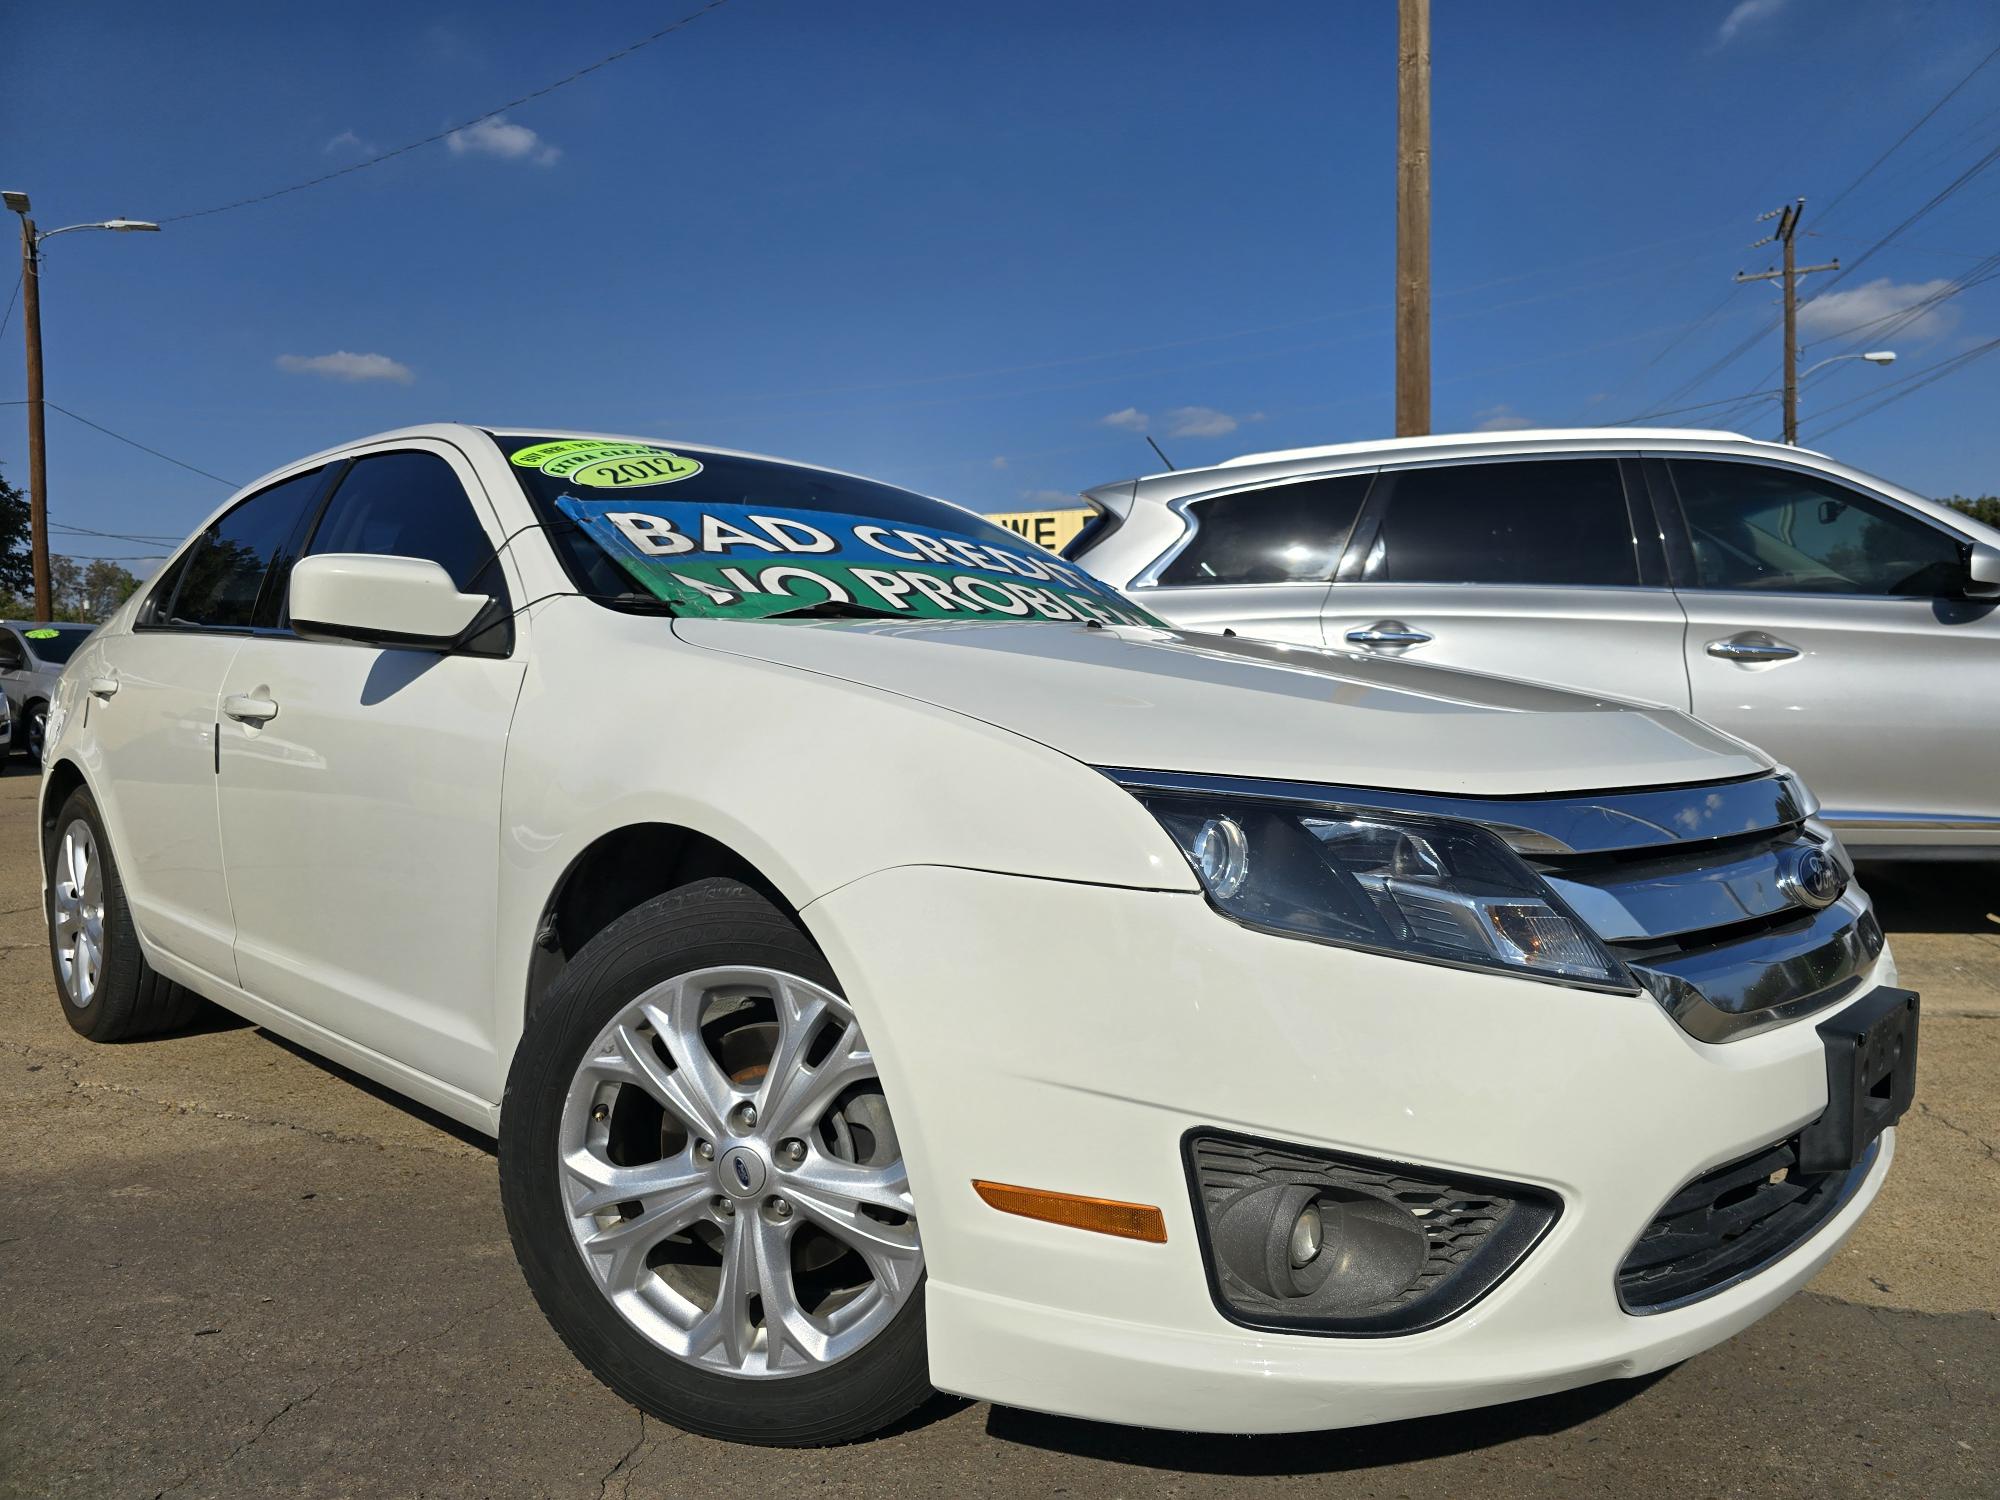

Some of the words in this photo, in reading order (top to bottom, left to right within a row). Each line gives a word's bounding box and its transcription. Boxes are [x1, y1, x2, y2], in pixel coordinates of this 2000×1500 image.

[550, 454, 599, 474] EXTRA
[596, 457, 686, 485] 2012
[604, 512, 837, 556] BAD
[852, 525, 1103, 596] CREDIT
[670, 566, 850, 604] NO
